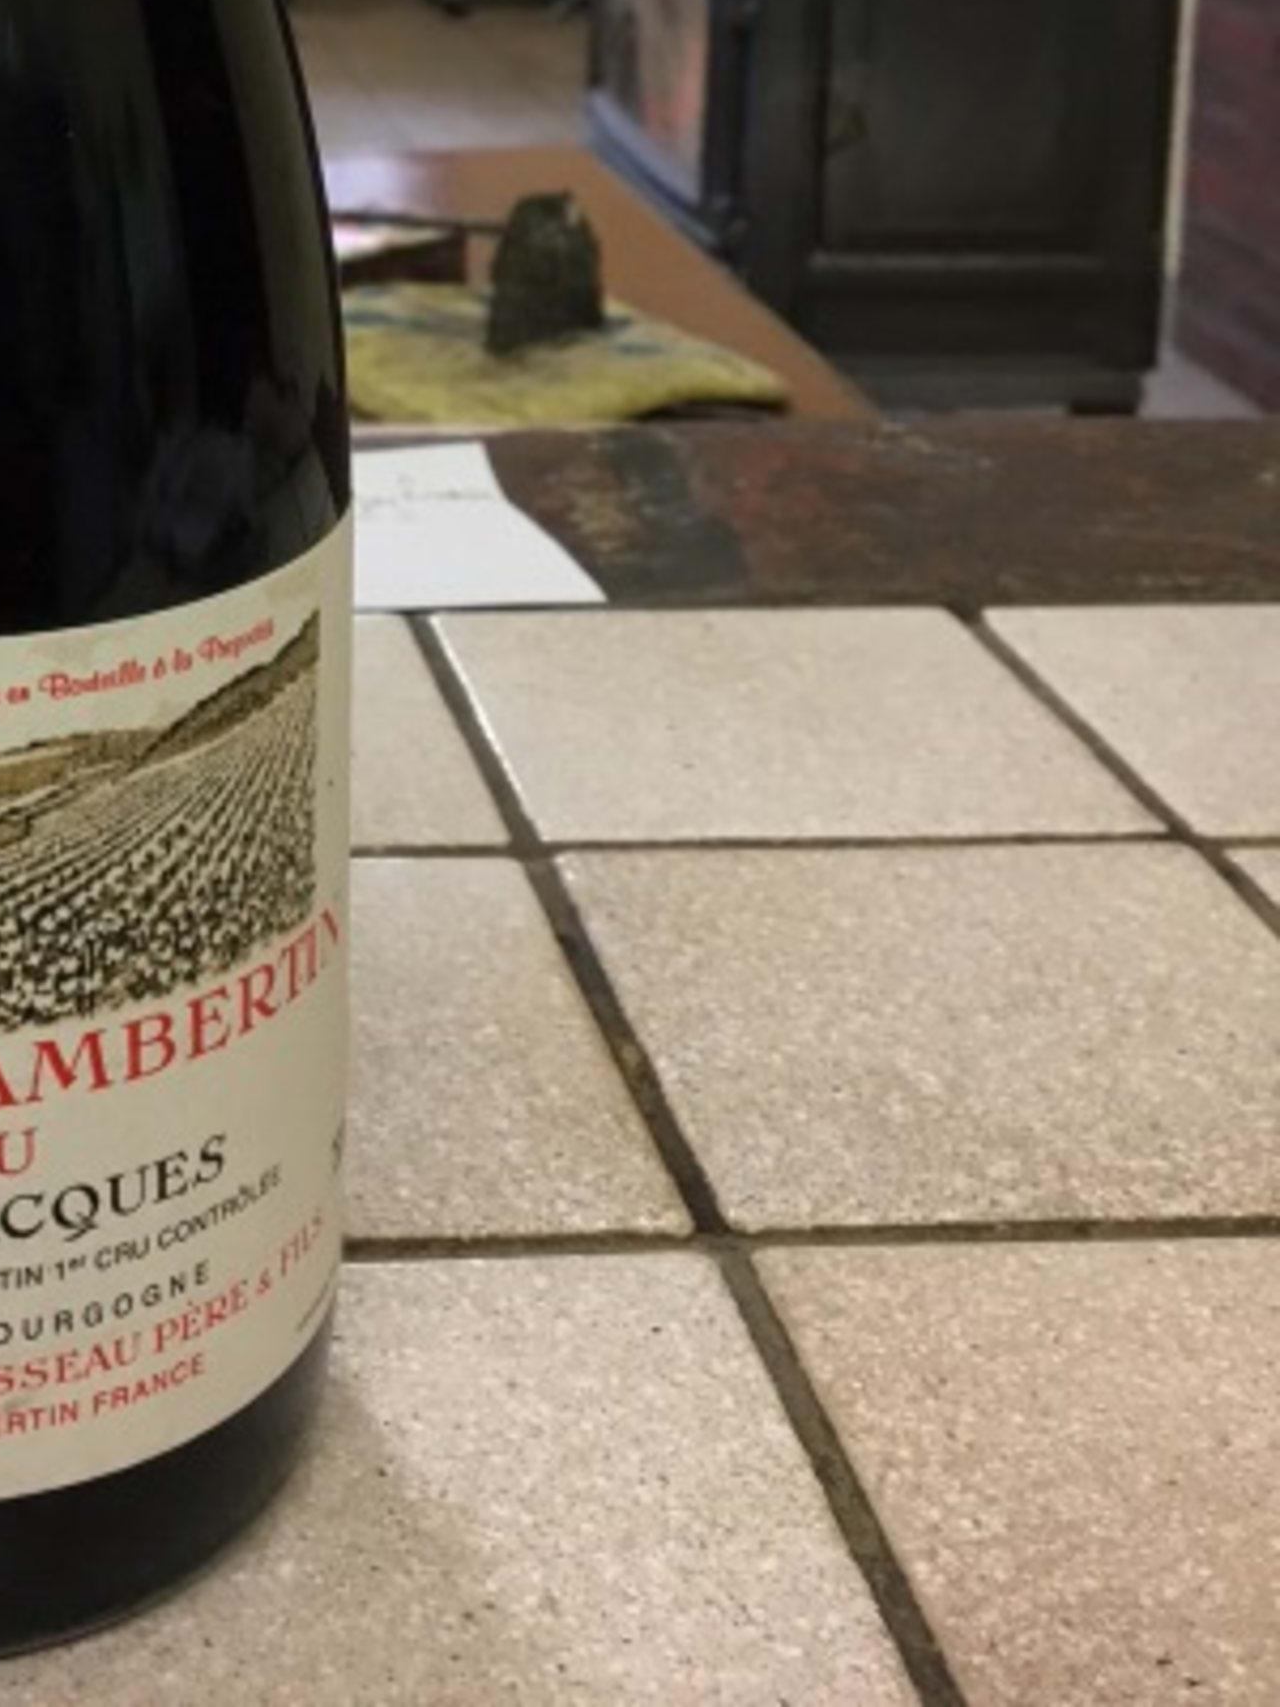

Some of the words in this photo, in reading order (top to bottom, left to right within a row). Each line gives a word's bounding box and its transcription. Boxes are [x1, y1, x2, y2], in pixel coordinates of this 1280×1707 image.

[6, 686, 31, 705] en
[38, 660, 147, 701] Bouteille
[56, 1255, 87, 1281] 1er
[94, 1232, 151, 1270] CRU
[152, 1279, 250, 1353] PÈRE
[92, 1351, 207, 1415] FRANCE
